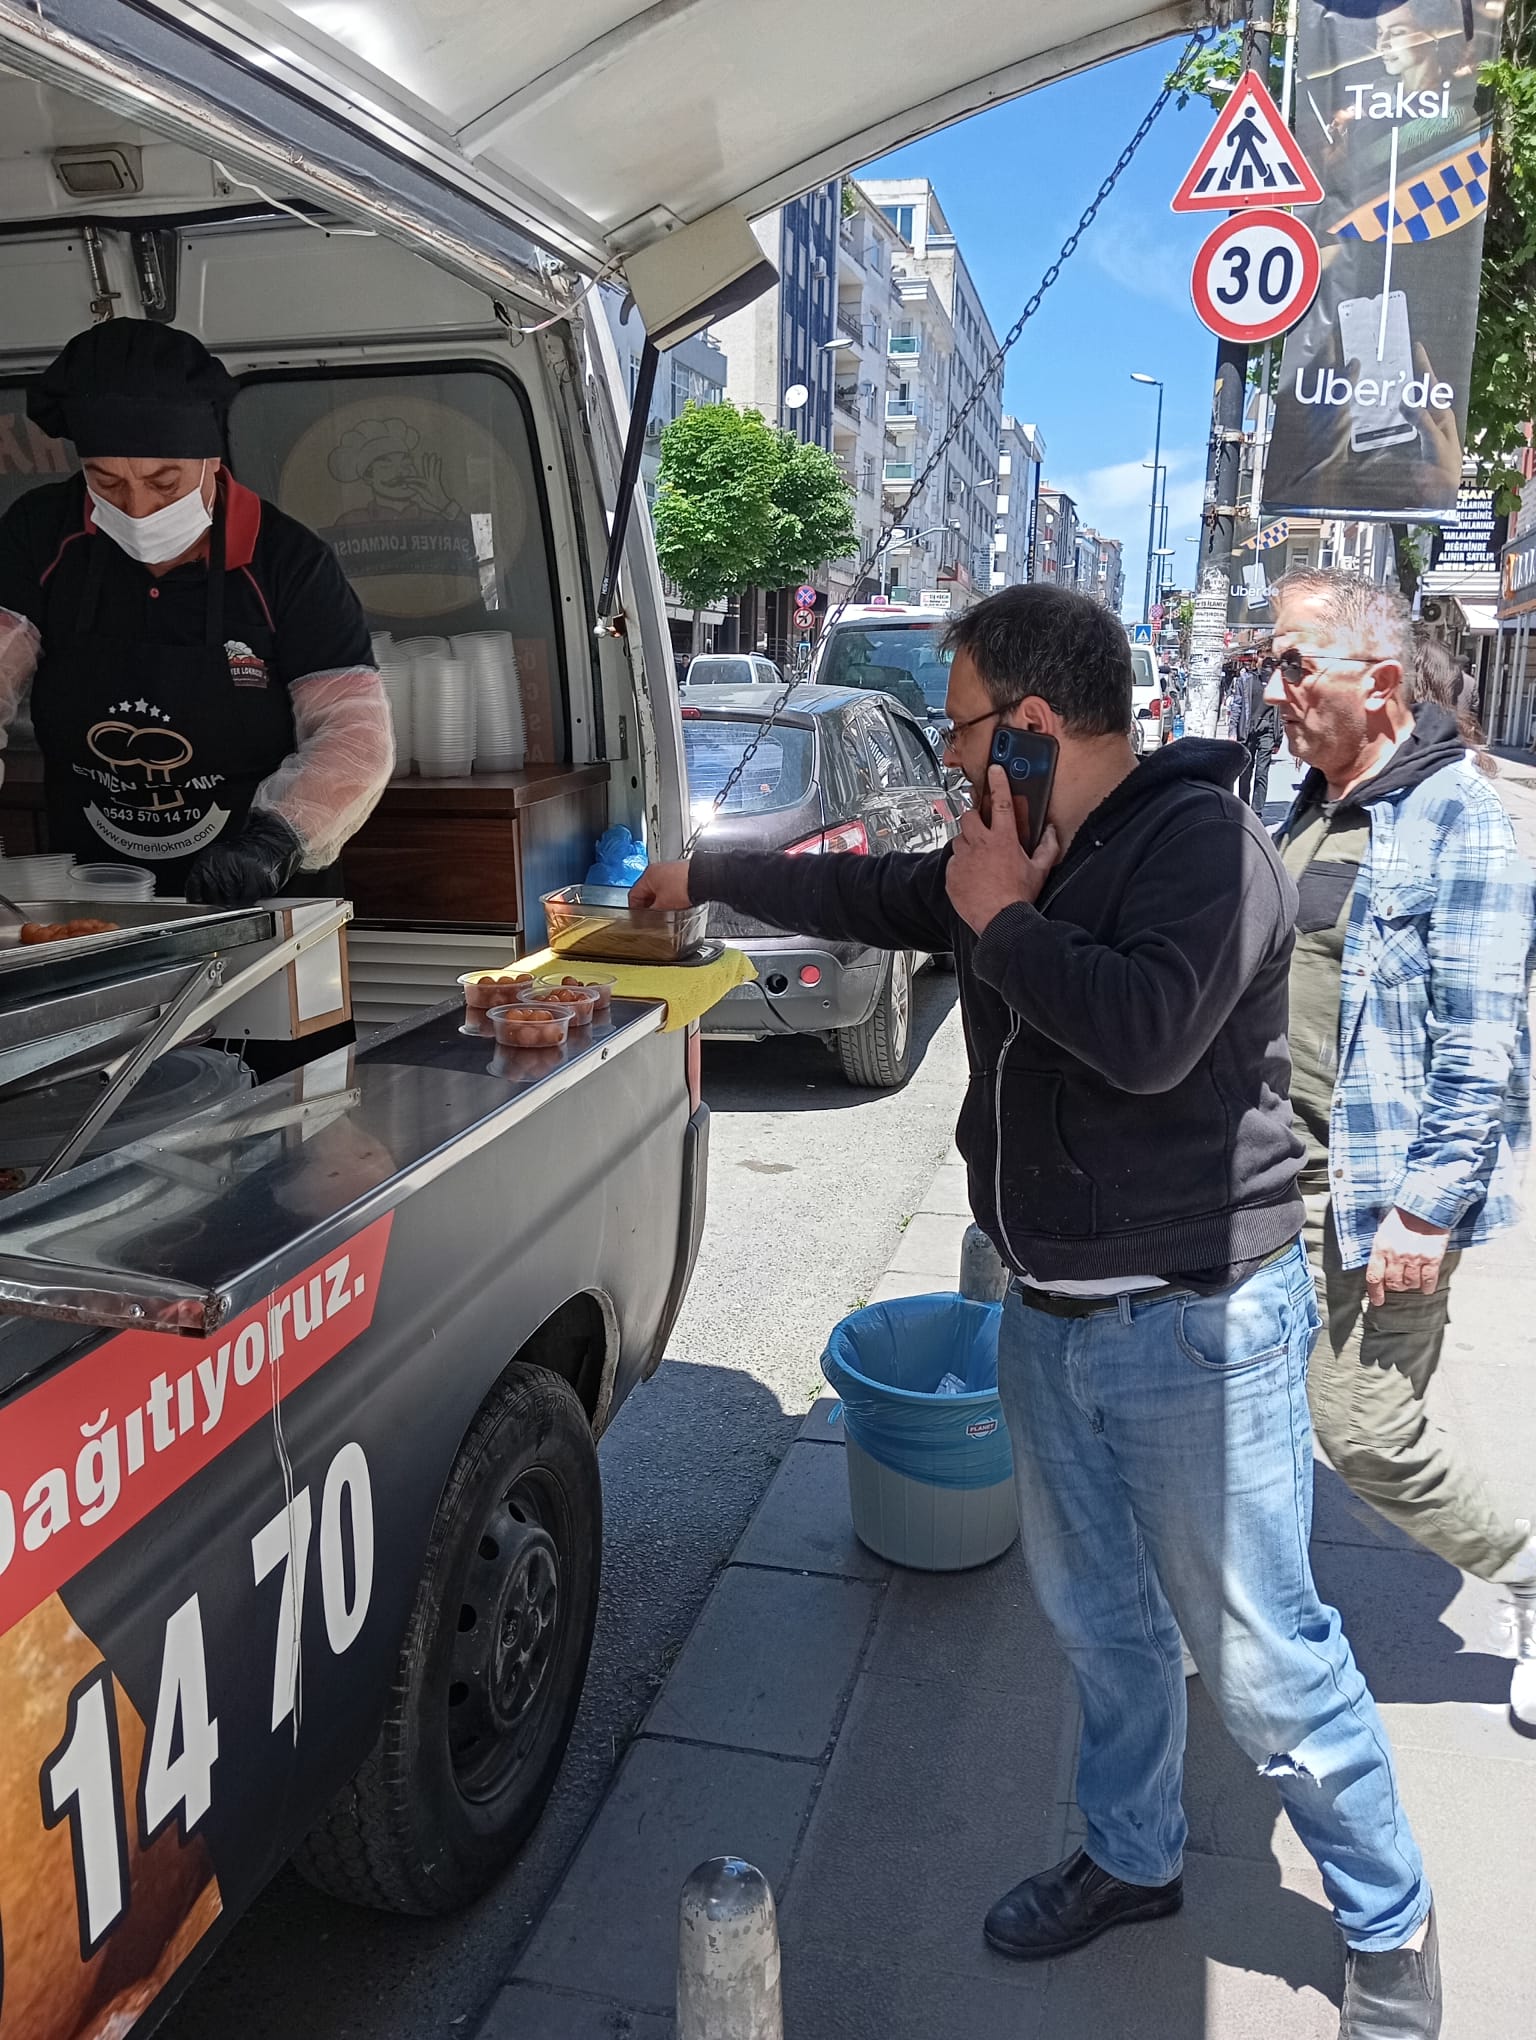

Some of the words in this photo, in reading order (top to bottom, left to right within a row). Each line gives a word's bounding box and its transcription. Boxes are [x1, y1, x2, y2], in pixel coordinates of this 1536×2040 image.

[1345, 81, 1450, 120] Taksi
[1216, 246, 1295, 306] 30
[137, 810, 160, 823] 570
[164, 811, 181, 823] 14
[183, 807, 201, 821] 70
[95, 820, 215, 853] www.eymenlokma.com
[970, 1423, 994, 1432] PLANET
[50, 1593, 218, 1944] 14
[251, 1441, 374, 1734] 70
